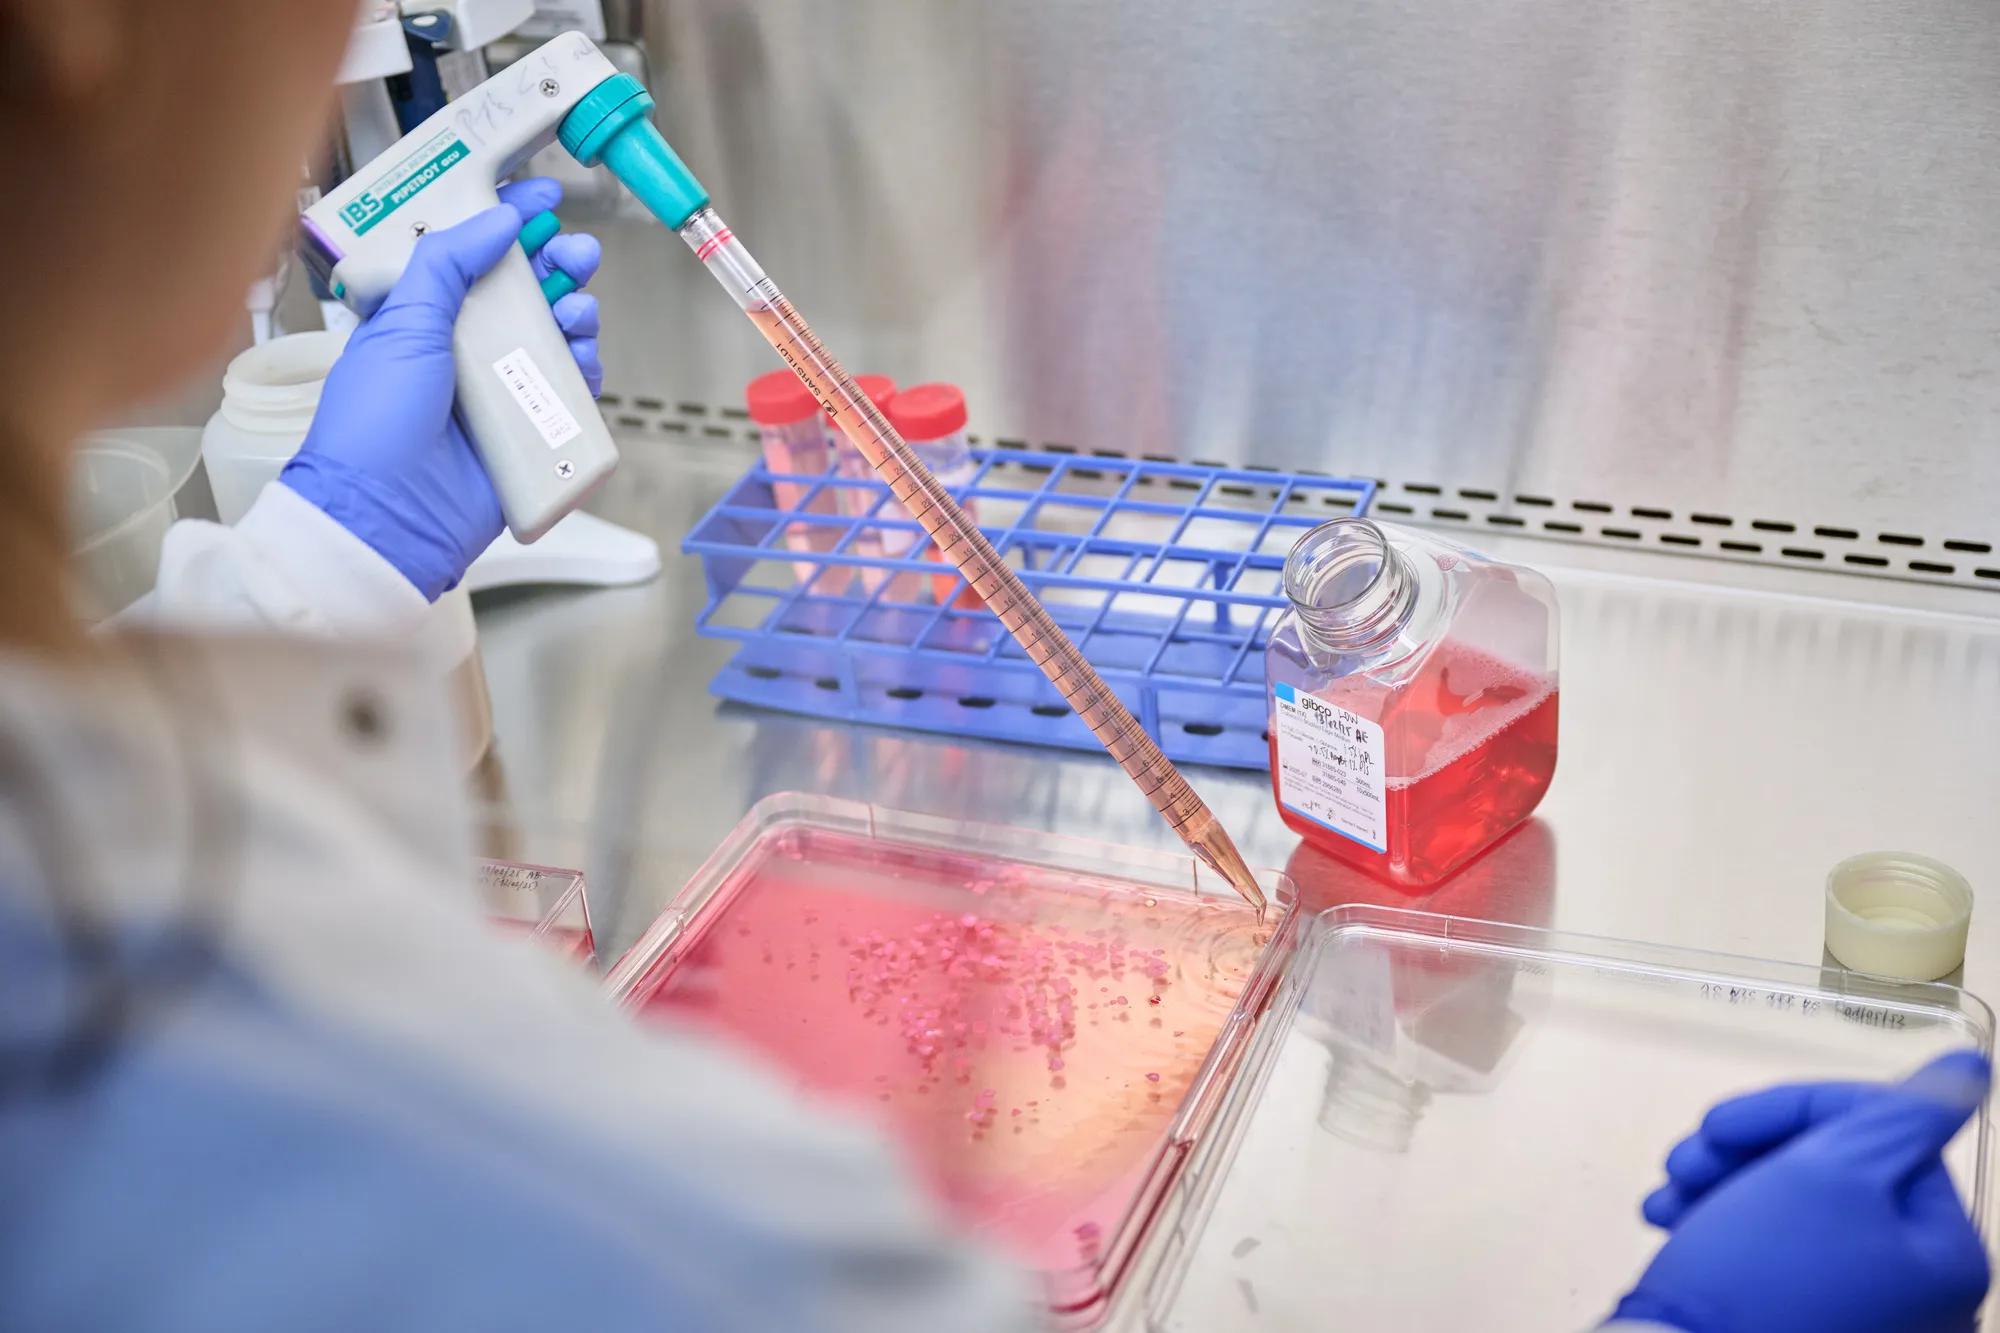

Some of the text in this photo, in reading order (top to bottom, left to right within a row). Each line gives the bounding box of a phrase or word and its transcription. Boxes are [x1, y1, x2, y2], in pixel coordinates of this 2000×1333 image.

[391, 162, 440, 204] PIPETBOY
[338, 192, 382, 228] IBS
[775, 343, 821, 396] SARSTEDT
[1302, 698, 1332, 717] gibco
